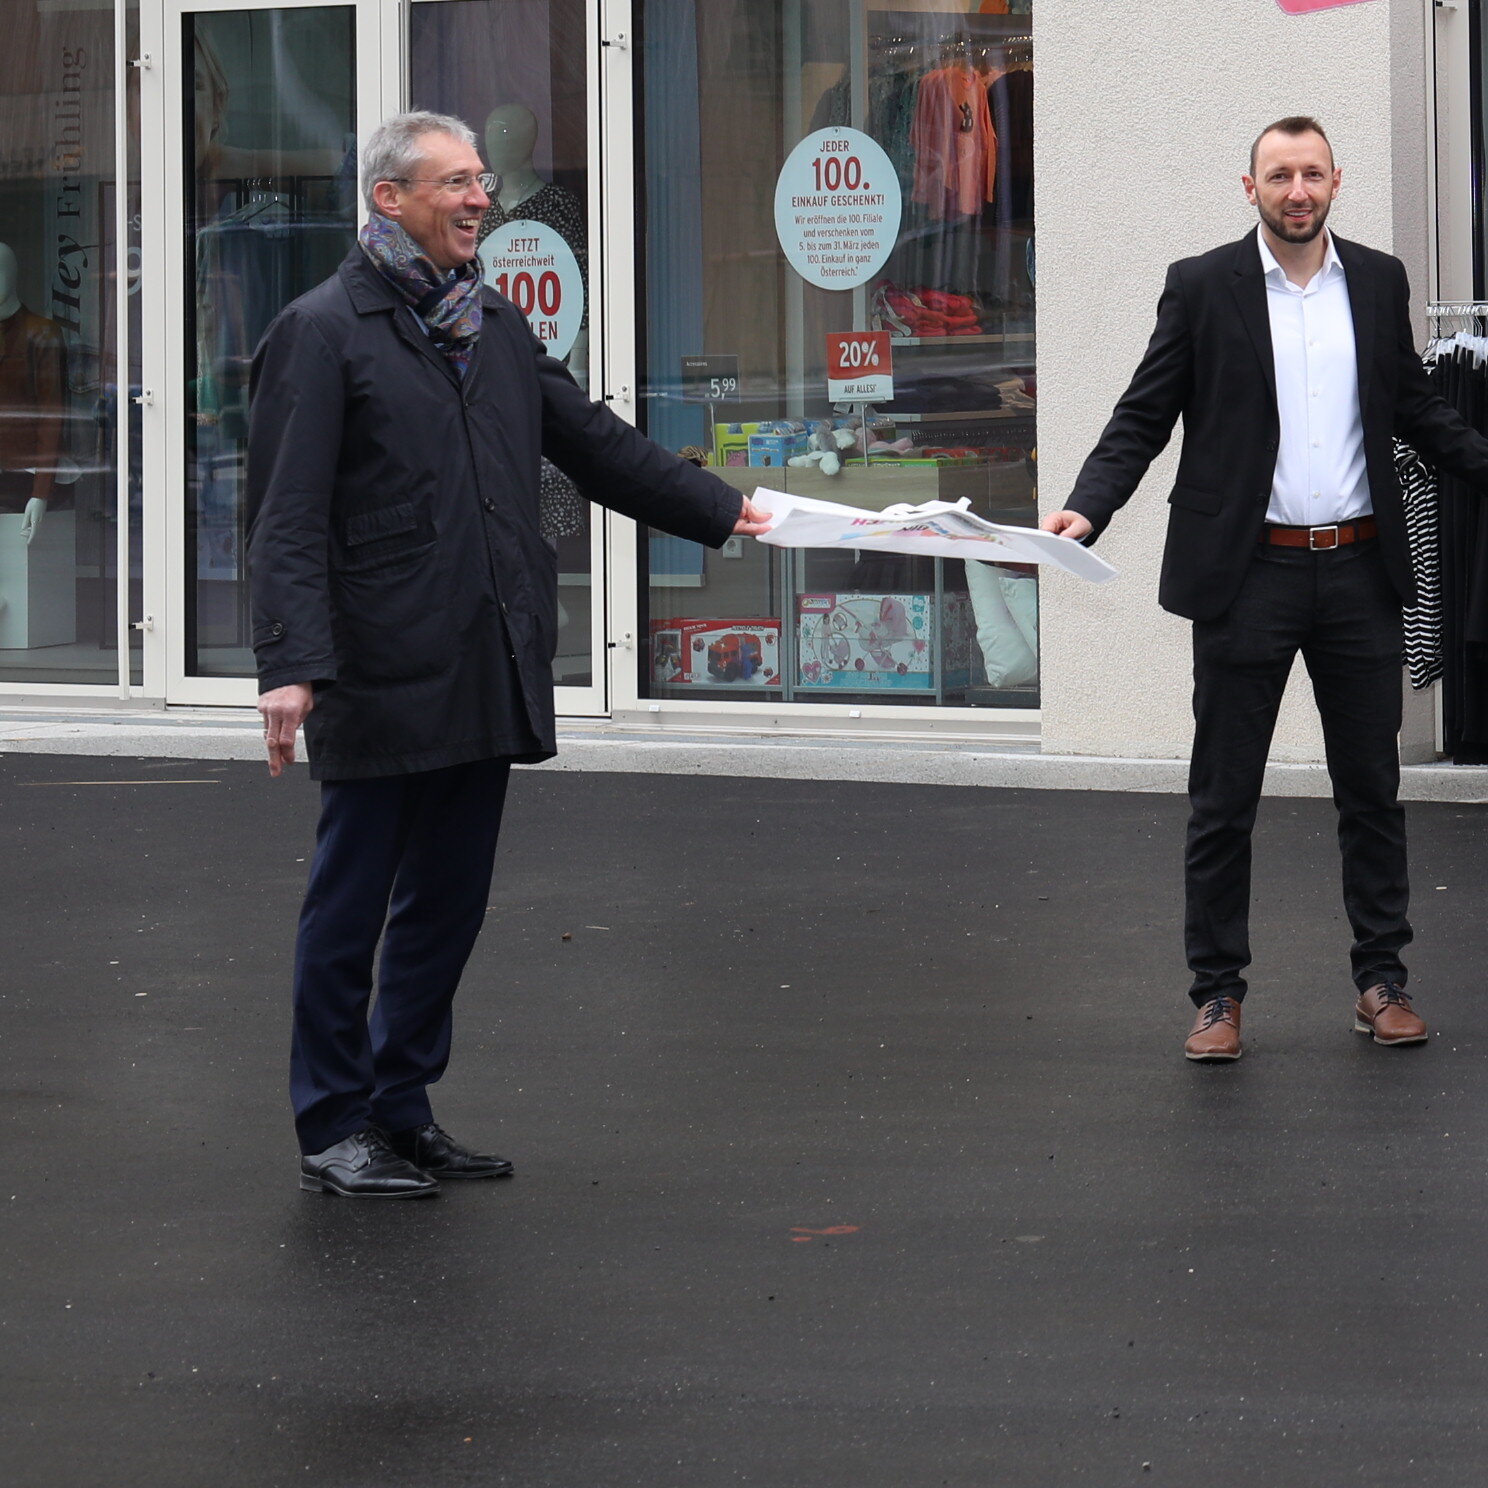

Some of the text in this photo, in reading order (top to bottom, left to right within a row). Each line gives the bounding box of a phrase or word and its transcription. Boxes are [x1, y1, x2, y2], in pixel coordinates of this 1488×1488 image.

[820, 140, 850, 152] JEDER
[812, 156, 870, 191] 100.
[52, 47, 100, 335] Hey Frühling
[792, 194, 884, 208] EINKAUF GESCHENKT!
[794, 214, 883, 224] Wir eröffnen die 100. Filiale
[804, 228, 874, 238] und verschenken vom
[507, 238, 540, 252] JETZT
[799, 242, 806, 251] 5.
[807, 241, 816, 250] bis
[843, 240, 859, 250] März
[860, 241, 880, 251] jeden
[492, 254, 555, 268] österreichweit
[822, 254, 846, 264] Einkauf
[848, 254, 854, 263] in
[855, 255, 871, 264] ganz
[495, 270, 562, 317] 100
[839, 340, 879, 368] 20%
[844, 384, 855, 393] AUF
